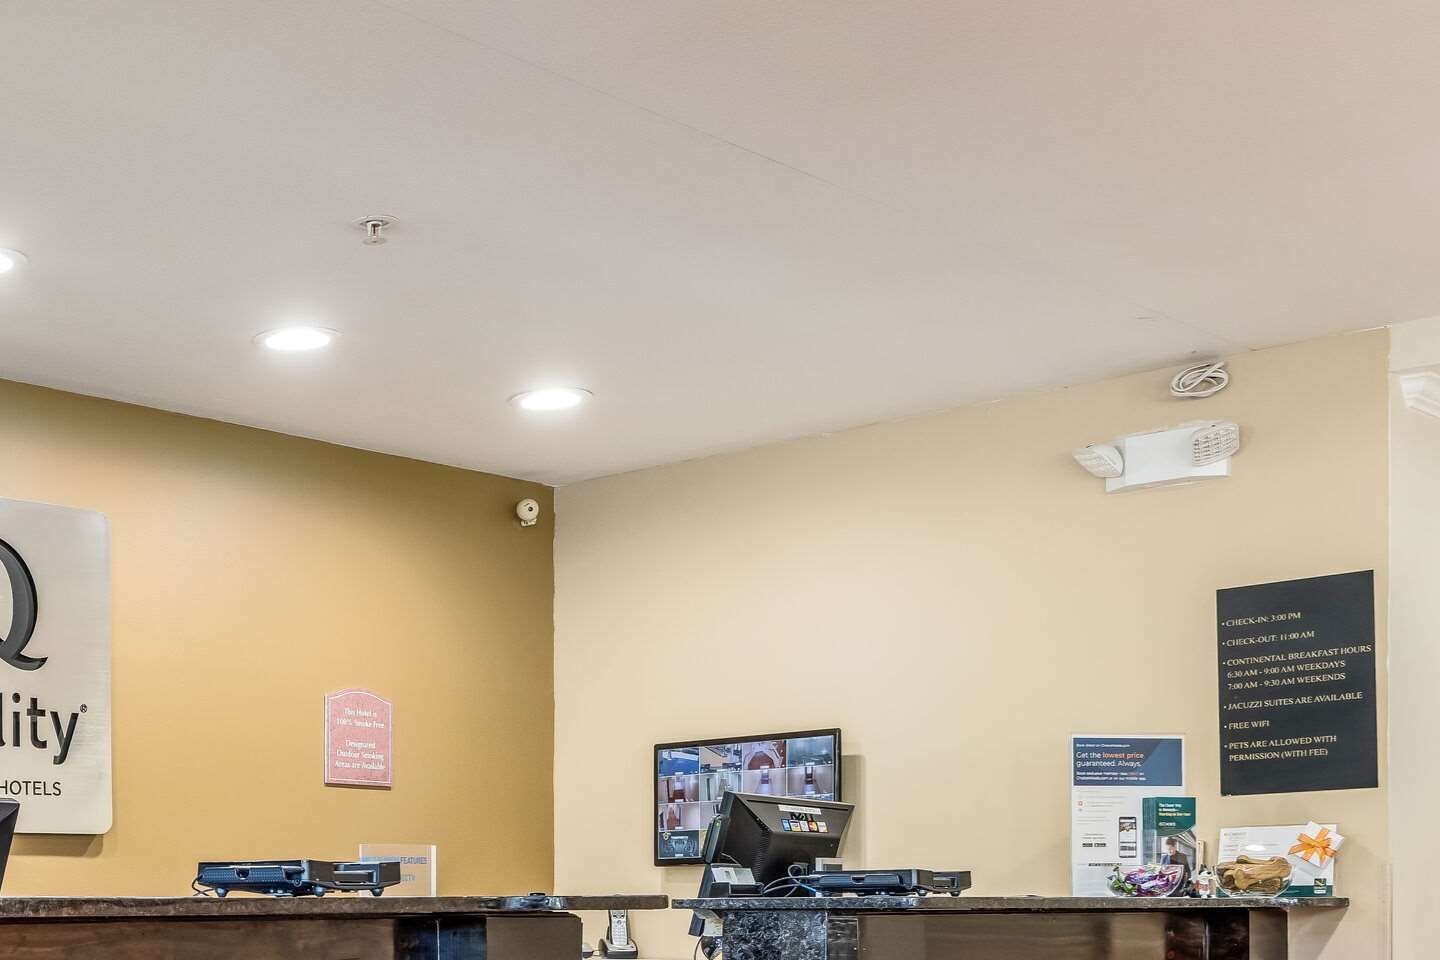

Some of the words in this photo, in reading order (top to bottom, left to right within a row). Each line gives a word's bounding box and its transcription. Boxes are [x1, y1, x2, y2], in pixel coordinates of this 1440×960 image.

[1271, 614, 1287, 622] 3:00
[1288, 612, 1301, 620] PM
[1280, 632, 1299, 641] 11:00
[1300, 630, 1315, 638] AM
[1227, 654, 1287, 667] CONTINENTAL
[1288, 648, 1339, 660] BREAKFAST
[1340, 644, 1372, 655] HOURS
[1227, 671, 1243, 679] 6:30
[1243, 669, 1258, 677] AM
[1263, 667, 1280, 675] 9:00
[1280, 665, 1295, 673] AM
[1296, 660, 1346, 671] WEEKDAYS
[1227, 682, 1243, 690] 7:00
[1243, 681, 1258, 689] AM
[1263, 679, 1280, 687] 9:30
[1280, 677, 1295, 686] AM
[1296, 672, 1346, 684] WEEKENDS
[1227, 700, 1262, 711] JACUZZI
[1263, 698, 1294, 708] SUITES
[1294, 696, 1313, 705] ARE
[1313, 691, 1363, 703] AVAILABLE
[1228, 721, 1250, 730] FREE
[1250, 720, 1270, 728] WIFI
[1228, 741, 1249, 750] PETS
[1249, 740, 1269, 748] ARE
[1269, 736, 1312, 747] ALLOWED
[1313, 735, 1337, 744] WITH
[1076, 751, 1089, 759] Get
[1089, 751, 1102, 759] the
[1102, 751, 1125, 760] lowest
[1126, 752, 1145, 761] price
[1229, 751, 1280, 762] PERMISSION
[1280, 749, 1307, 760] (WITH
[1308, 748, 1328, 757] FEE)
